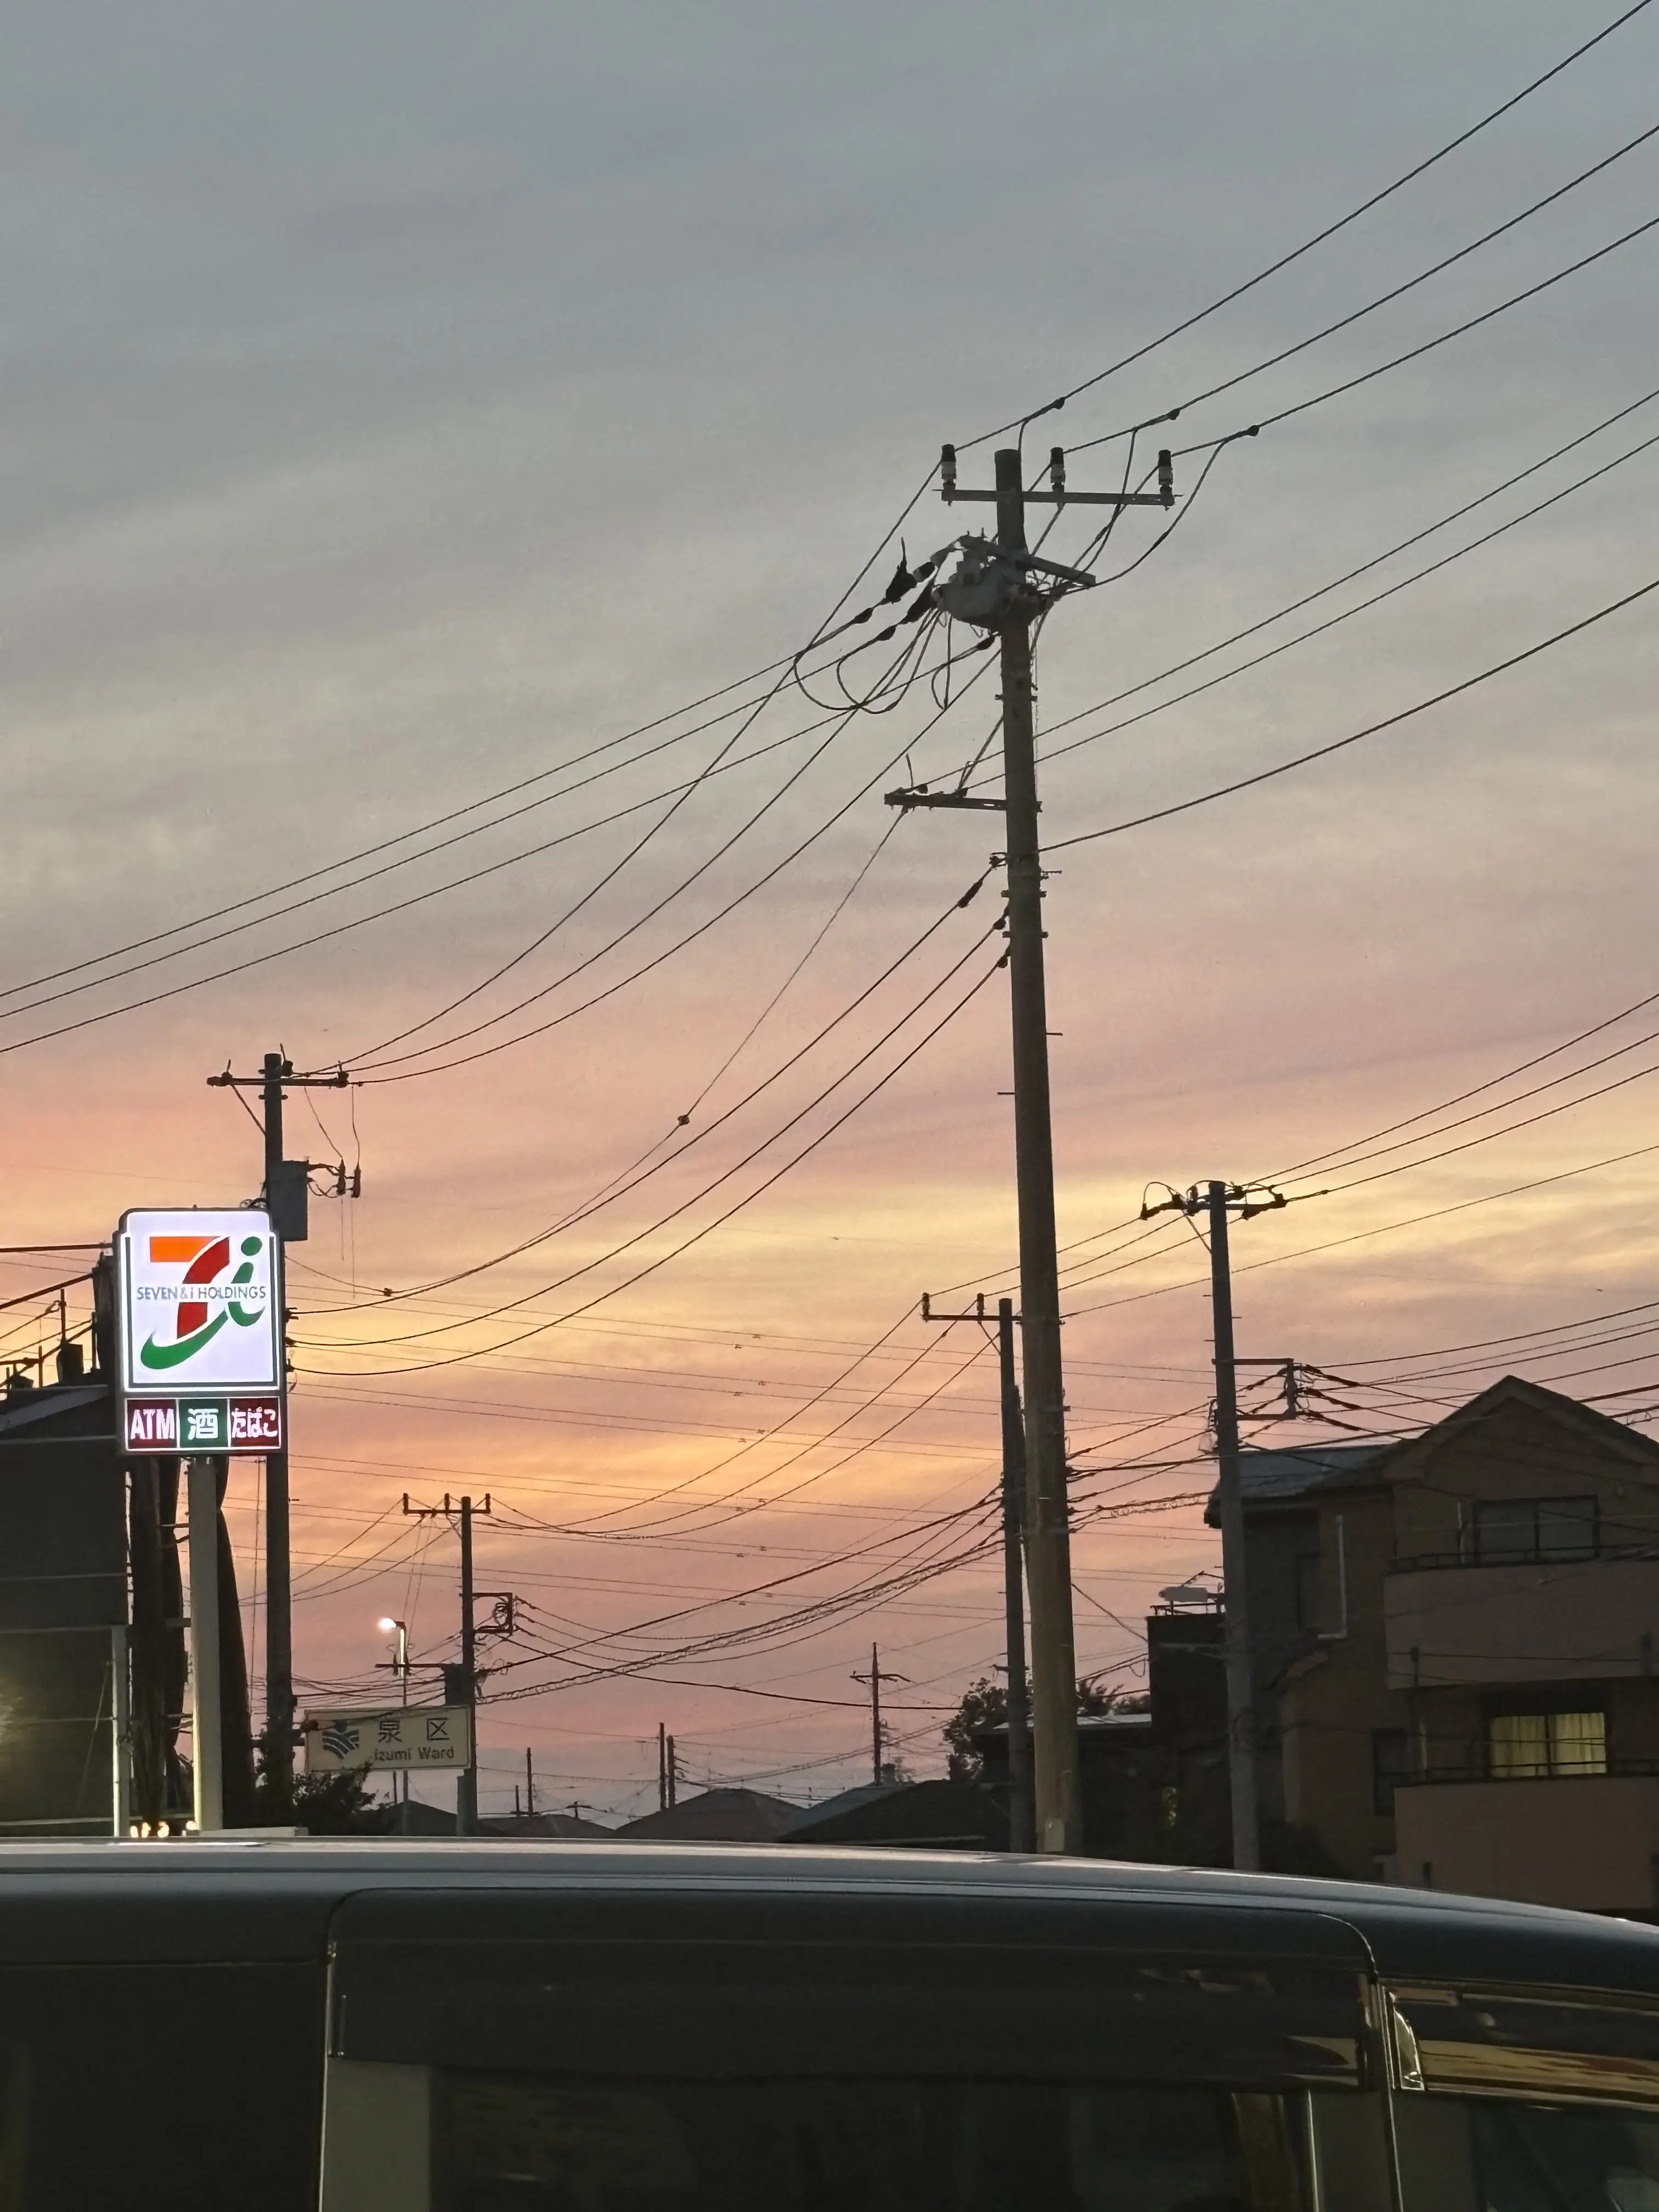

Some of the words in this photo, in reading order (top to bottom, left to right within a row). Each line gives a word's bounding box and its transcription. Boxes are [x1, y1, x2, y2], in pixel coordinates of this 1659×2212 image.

[198, 1286, 266, 1299] HOLDINGS
[130, 1408, 175, 1440] ATM
[188, 1408, 218, 1440] 酒
[231, 1407, 278, 1438] たばこ
[375, 1747, 412, 1761] Izumi
[417, 1746, 454, 1760] Ward
